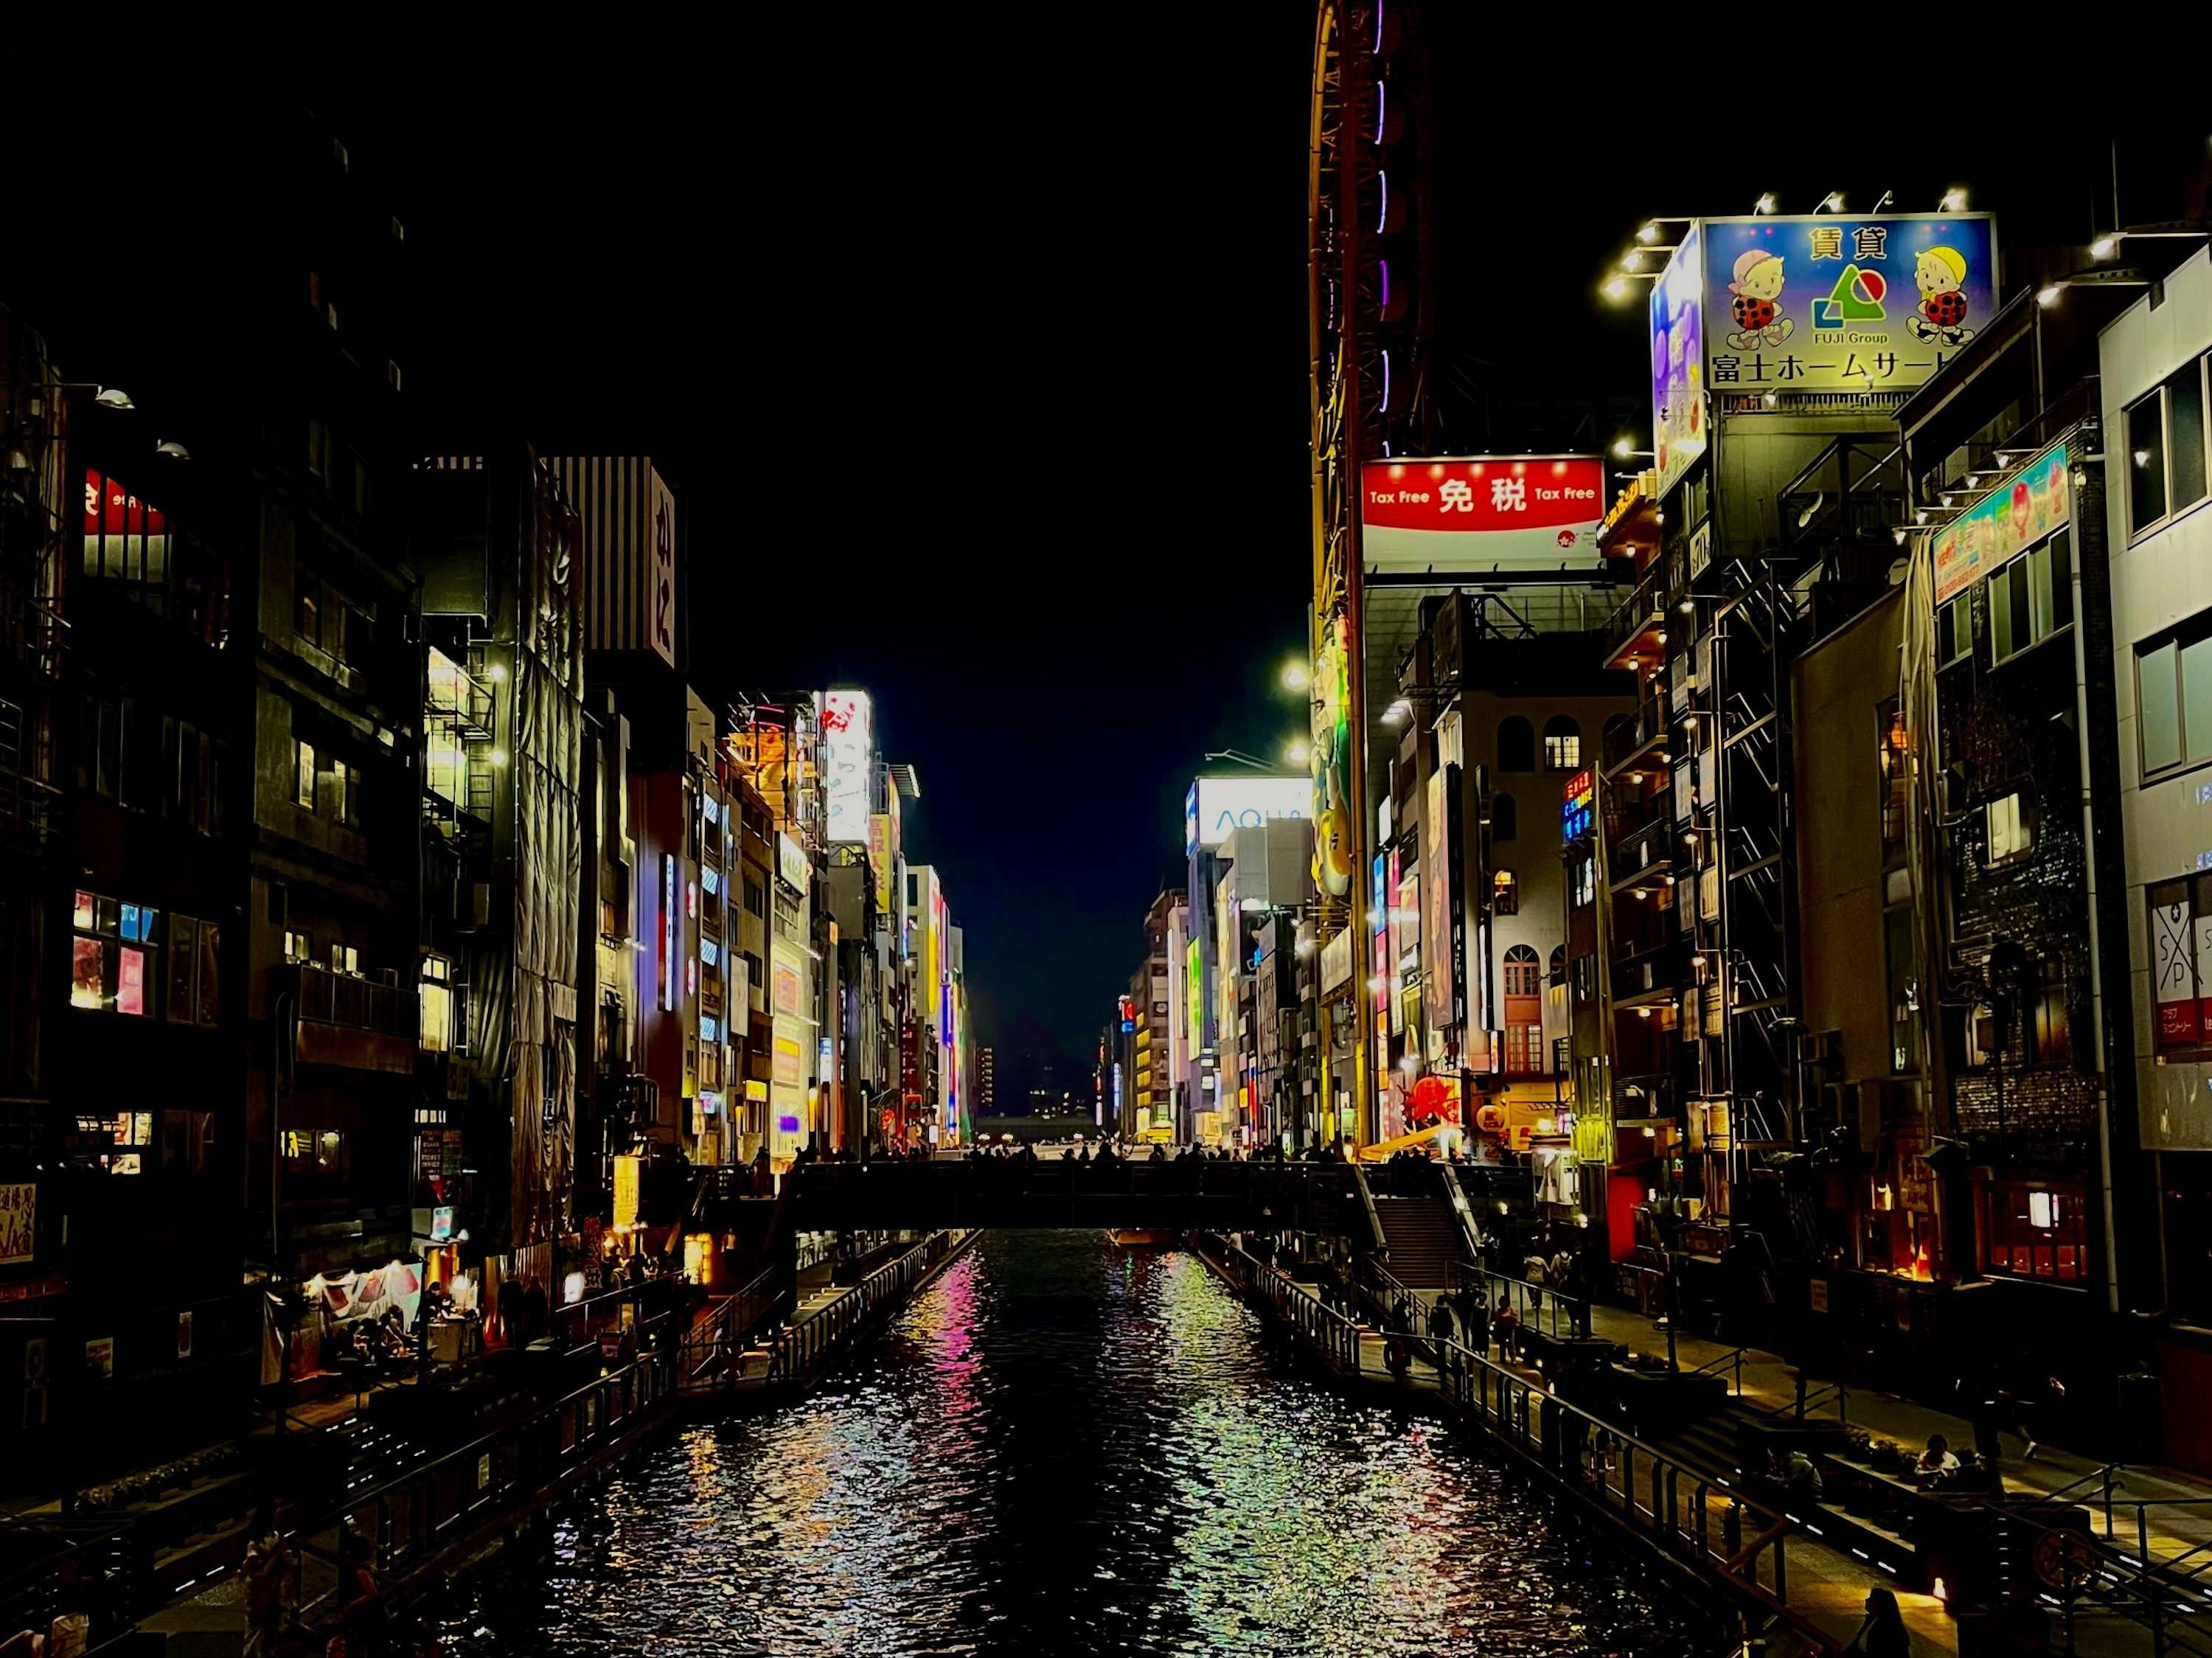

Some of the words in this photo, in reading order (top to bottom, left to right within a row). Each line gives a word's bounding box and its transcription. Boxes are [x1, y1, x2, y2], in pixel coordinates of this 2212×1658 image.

[1809, 227, 1887, 260] 賃貸
[1815, 334, 1844, 344] FUJI
[1849, 333, 1888, 345] Group
[1370, 491, 1394, 504] Tax
[1399, 490, 1430, 504] Free
[1439, 478, 1527, 513] 免税
[1534, 487, 1559, 501] Tax
[1564, 487, 1595, 500] Free
